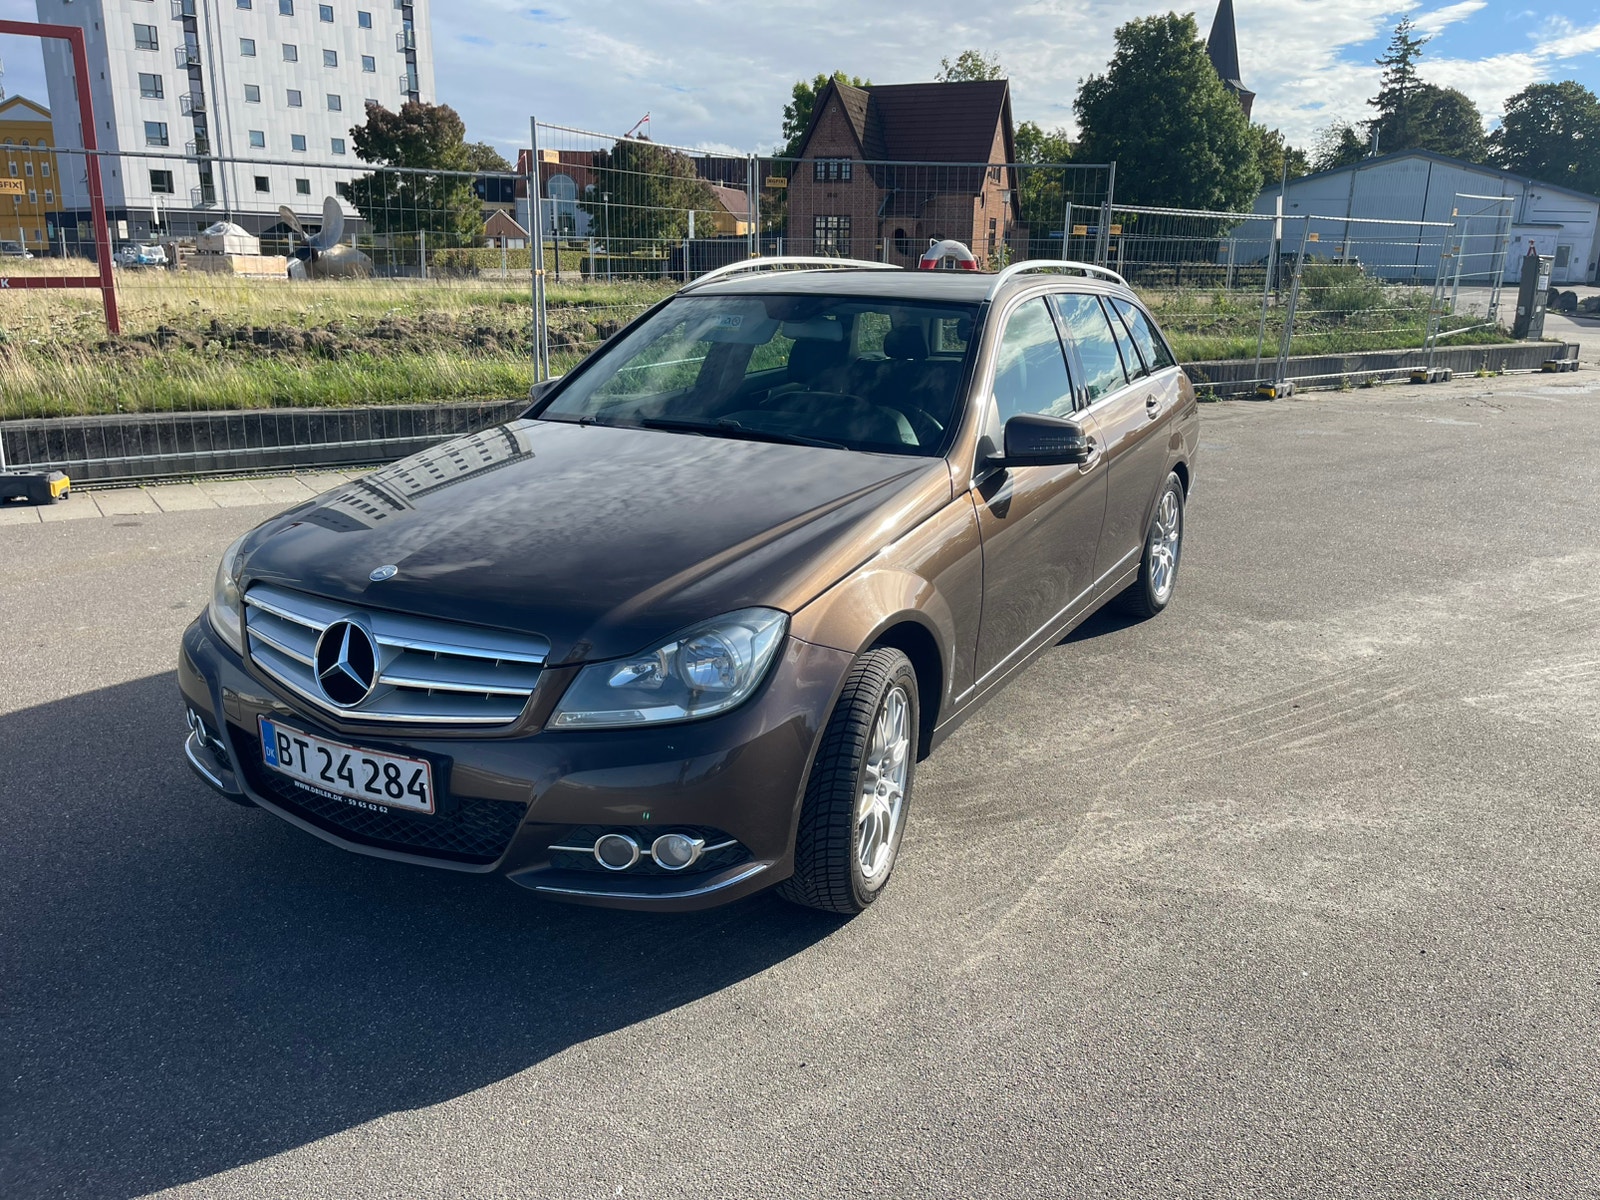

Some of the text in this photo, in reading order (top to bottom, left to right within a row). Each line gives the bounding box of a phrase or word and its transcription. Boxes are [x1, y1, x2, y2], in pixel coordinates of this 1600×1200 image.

[266, 746, 275, 758] DK
[277, 731, 427, 804] BT 24 284
[348, 798, 357, 806] 59
[368, 803, 377, 811] 62
[379, 805, 388, 813] 62
